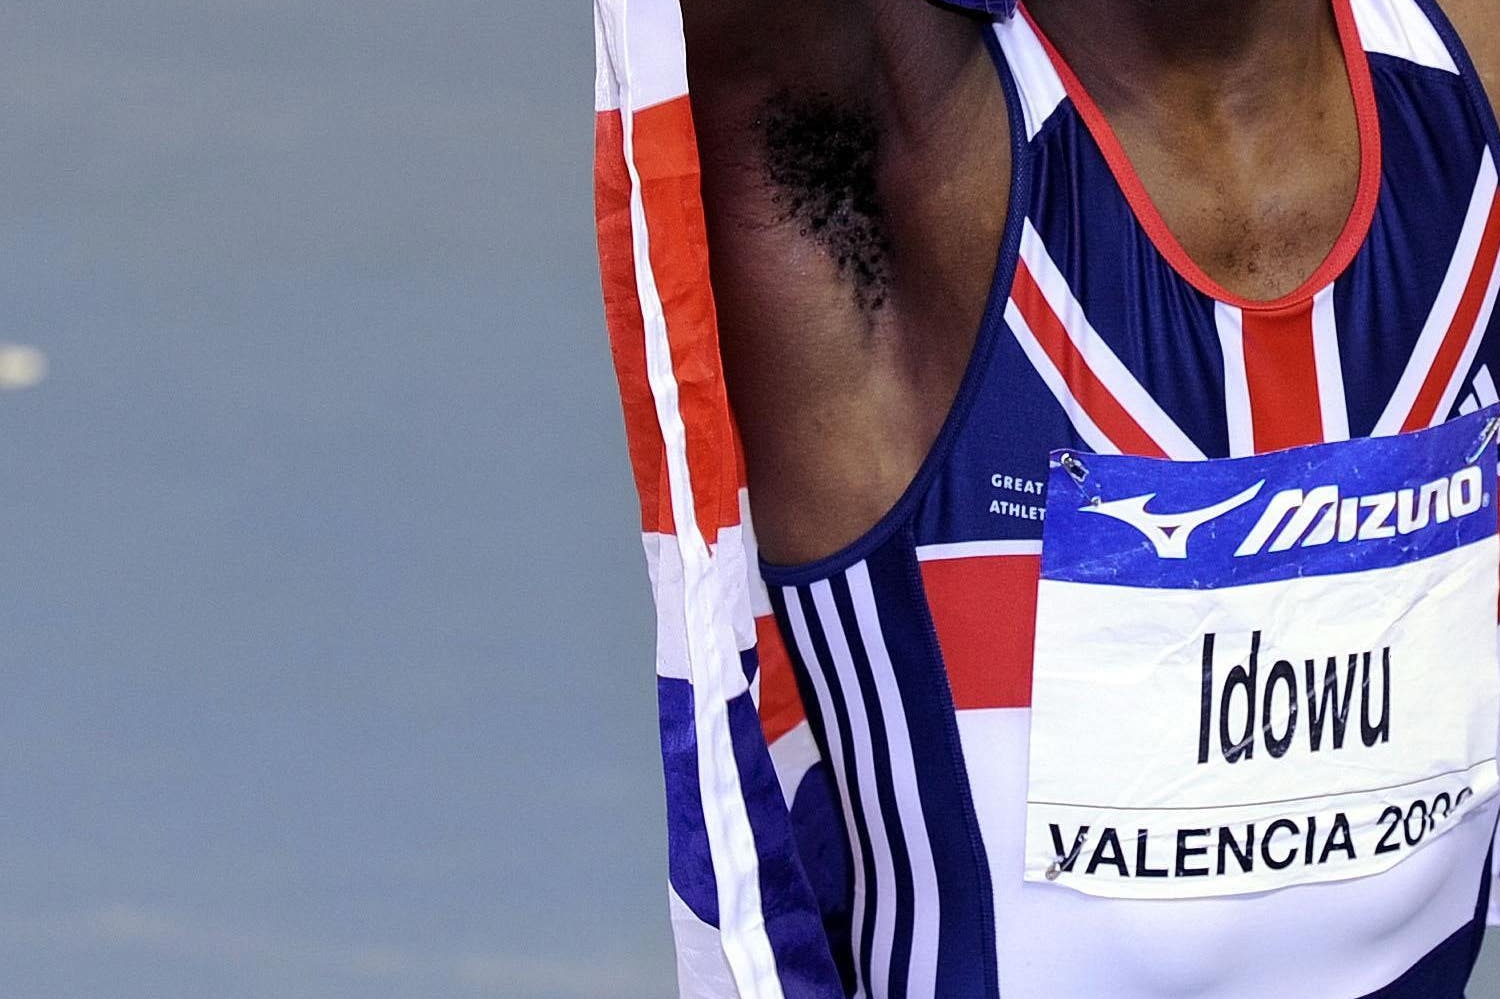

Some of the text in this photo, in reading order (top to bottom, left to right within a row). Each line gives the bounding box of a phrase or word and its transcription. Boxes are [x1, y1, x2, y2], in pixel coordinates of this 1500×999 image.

[991, 473, 1045, 495] GREAT
[1233, 465, 1483, 558] MIZUNO
[1197, 630, 1391, 765] Idowu
[1048, 812, 1357, 878] VALENCIA
